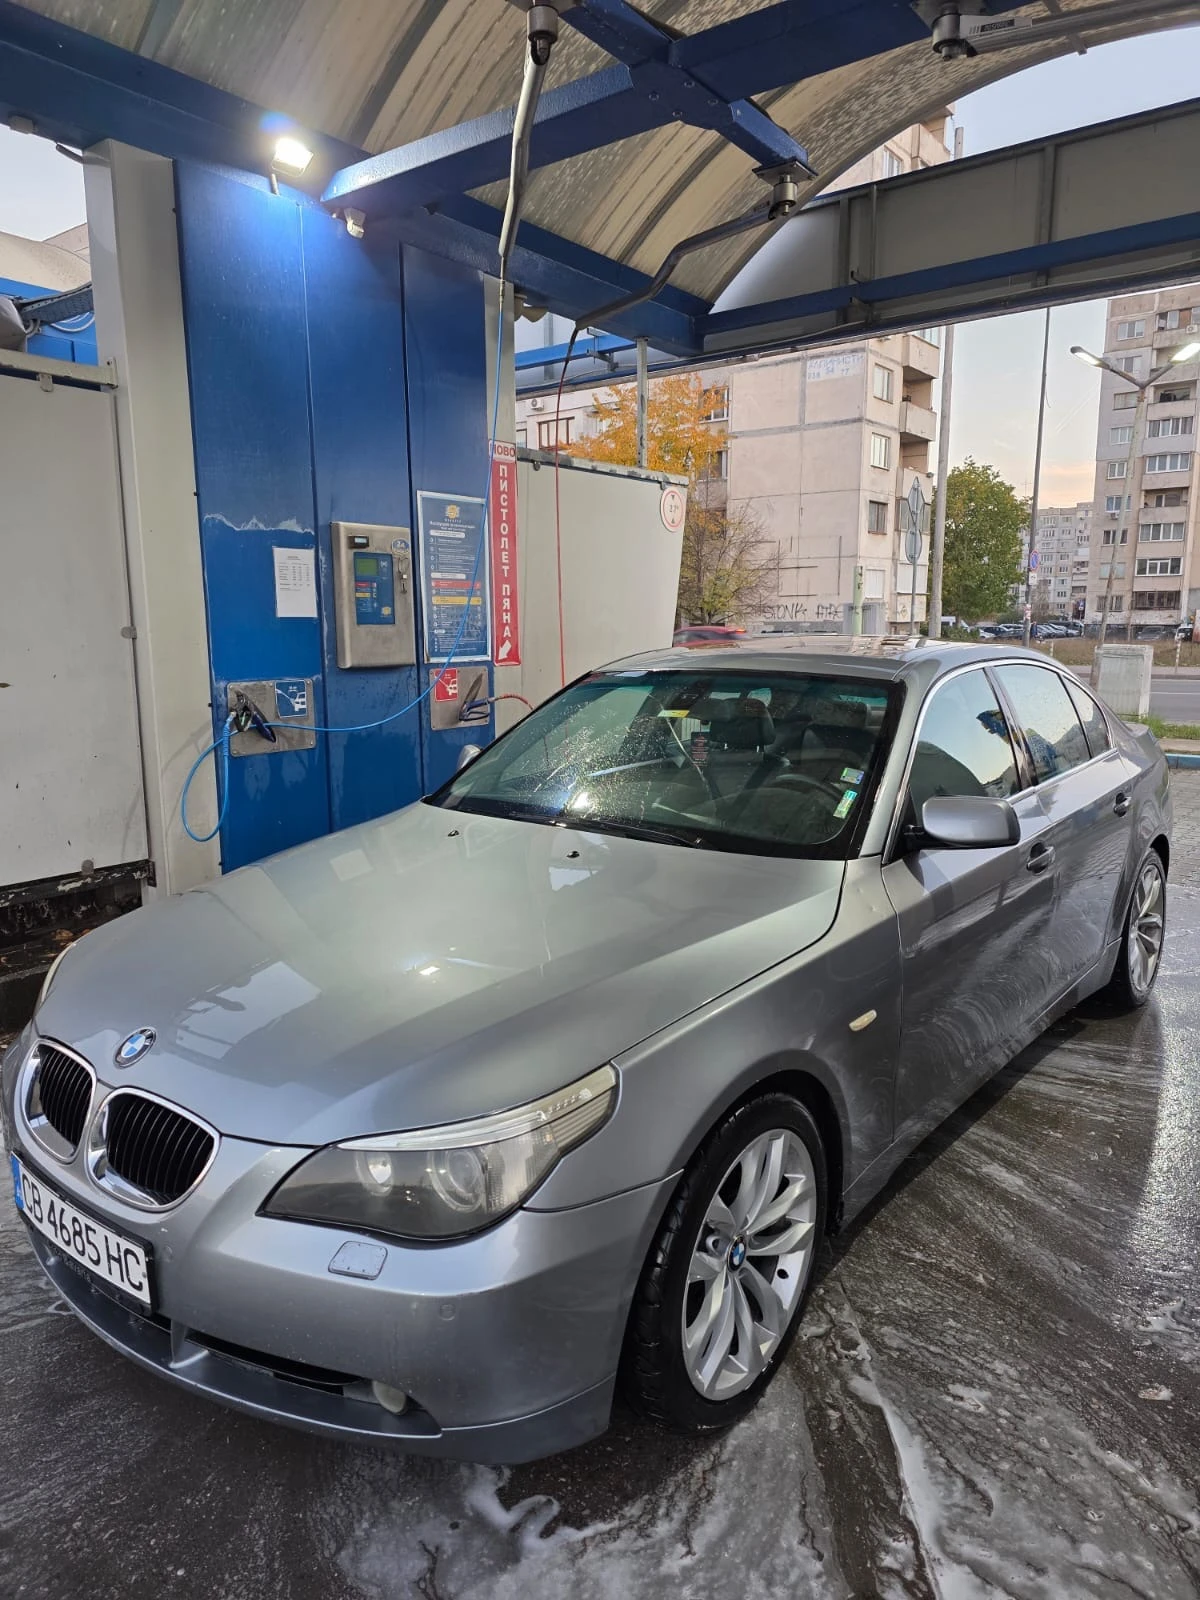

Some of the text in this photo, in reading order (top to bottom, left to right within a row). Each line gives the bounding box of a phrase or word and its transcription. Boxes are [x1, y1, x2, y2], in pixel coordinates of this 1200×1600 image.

[499, 464, 512, 638] ПИСТОЛЕТ ПЯНА
[22, 1173, 43, 1223] CB
[47, 1199, 101, 1266] 4685
[104, 1234, 143, 1292] HC
